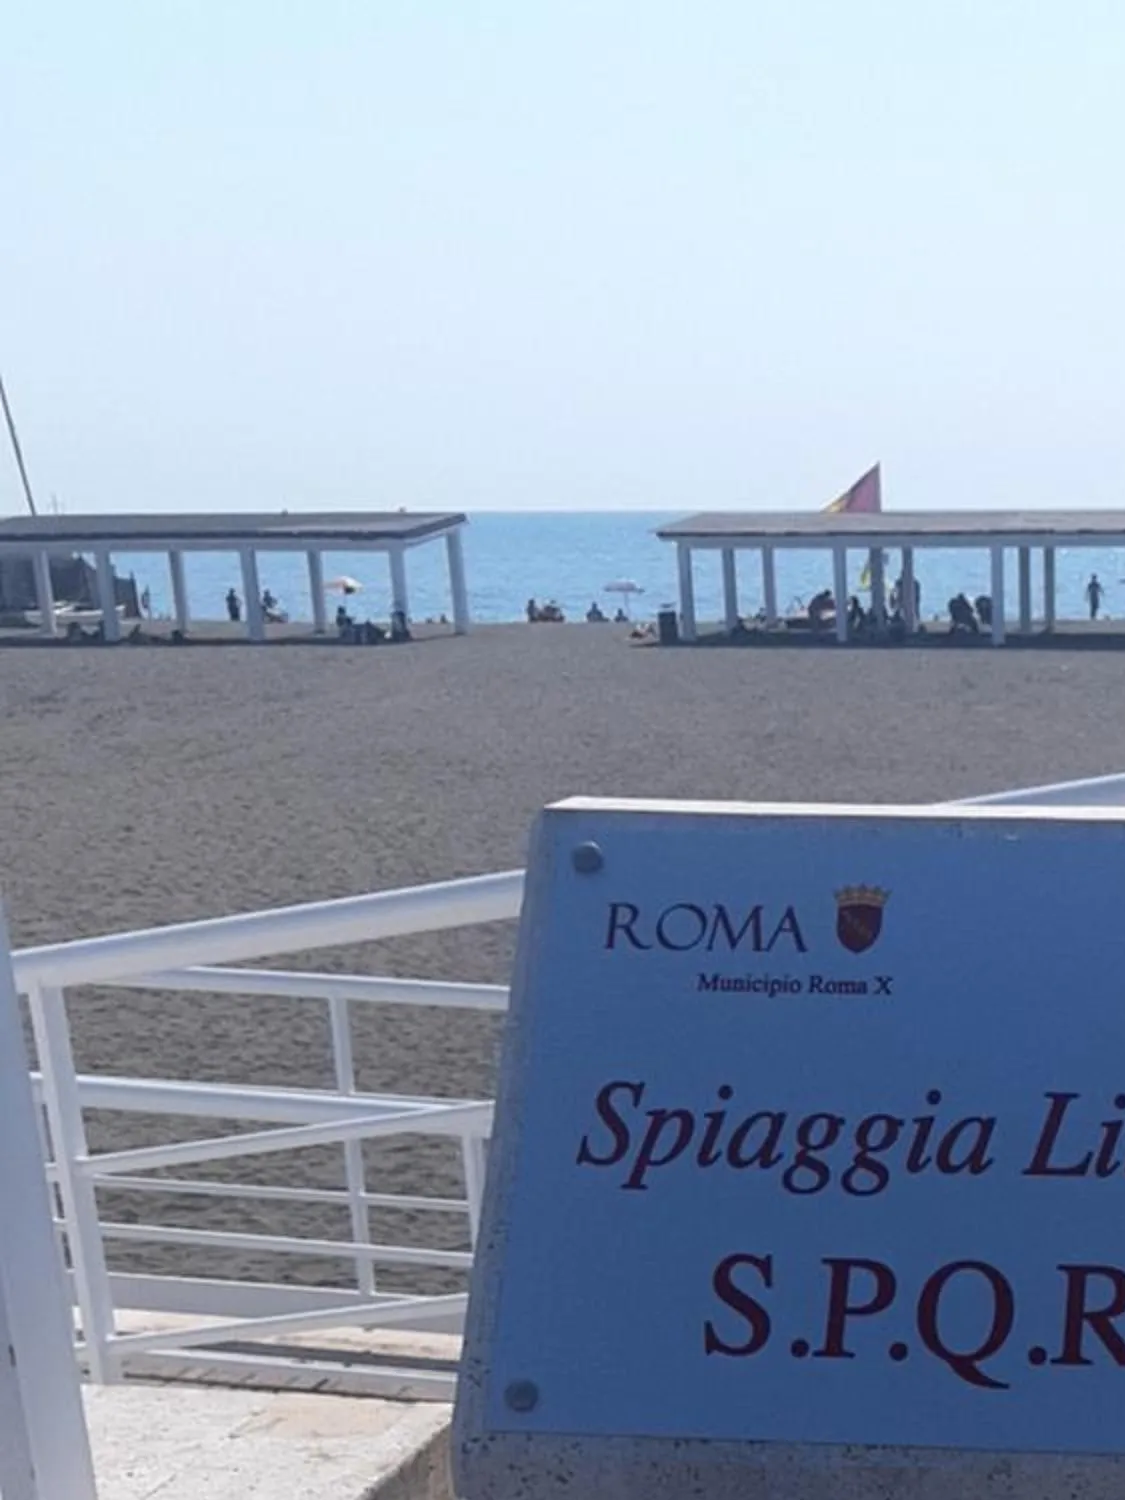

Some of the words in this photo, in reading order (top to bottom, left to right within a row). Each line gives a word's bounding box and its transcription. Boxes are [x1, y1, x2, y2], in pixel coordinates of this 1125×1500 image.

[604, 902, 809, 952] ROMA
[697, 972, 802, 998] Municipio
[808, 975, 869, 995] Roma
[873, 976, 893, 996] X
[576, 1081, 997, 1197] Spiaggia
